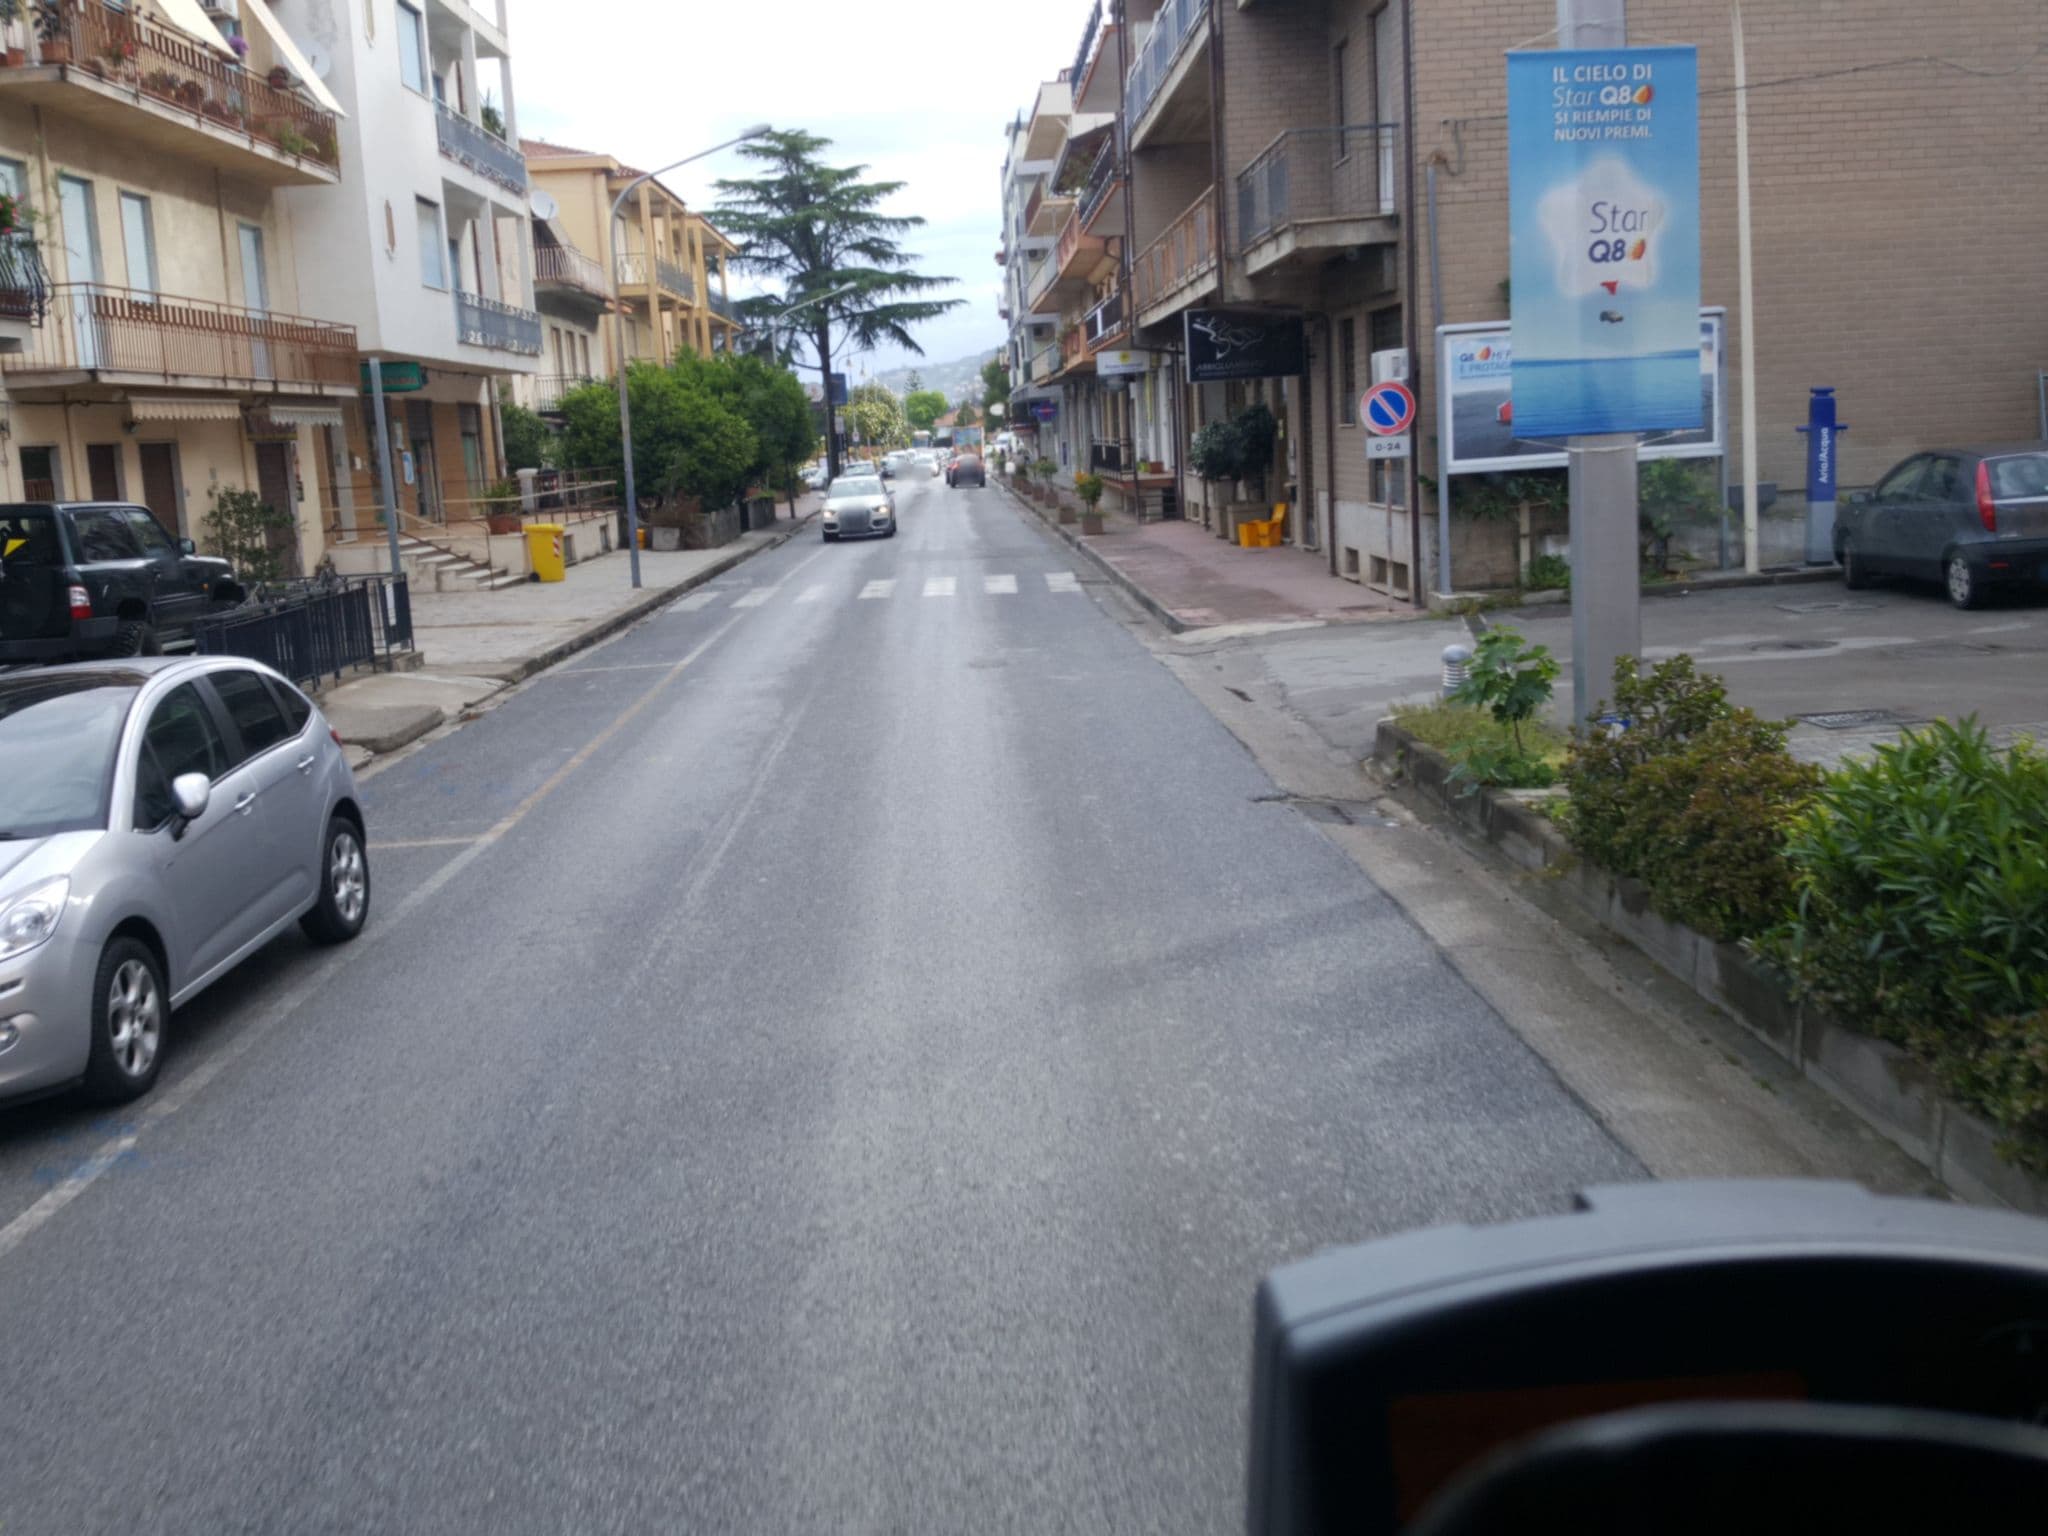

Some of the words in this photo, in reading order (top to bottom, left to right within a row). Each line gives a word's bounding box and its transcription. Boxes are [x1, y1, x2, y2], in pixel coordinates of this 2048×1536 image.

[1553, 66, 1569, 83] IL
[1574, 64, 1627, 82] CIELO
[1633, 63, 1652, 80] DI
[1552, 86, 1594, 108] Star
[1600, 85, 1632, 106] Q8
[1555, 111, 1568, 125] SI
[1572, 109, 1632, 123] RIEMPIE
[1636, 107, 1652, 121] DI
[1554, 127, 1600, 142] NUOVI
[1590, 201, 1648, 233] Star
[1588, 239, 1626, 264] Q8
[1375, 442, 1400, 453] 0-24
[1818, 427, 1831, 483] Aria/Acqua
